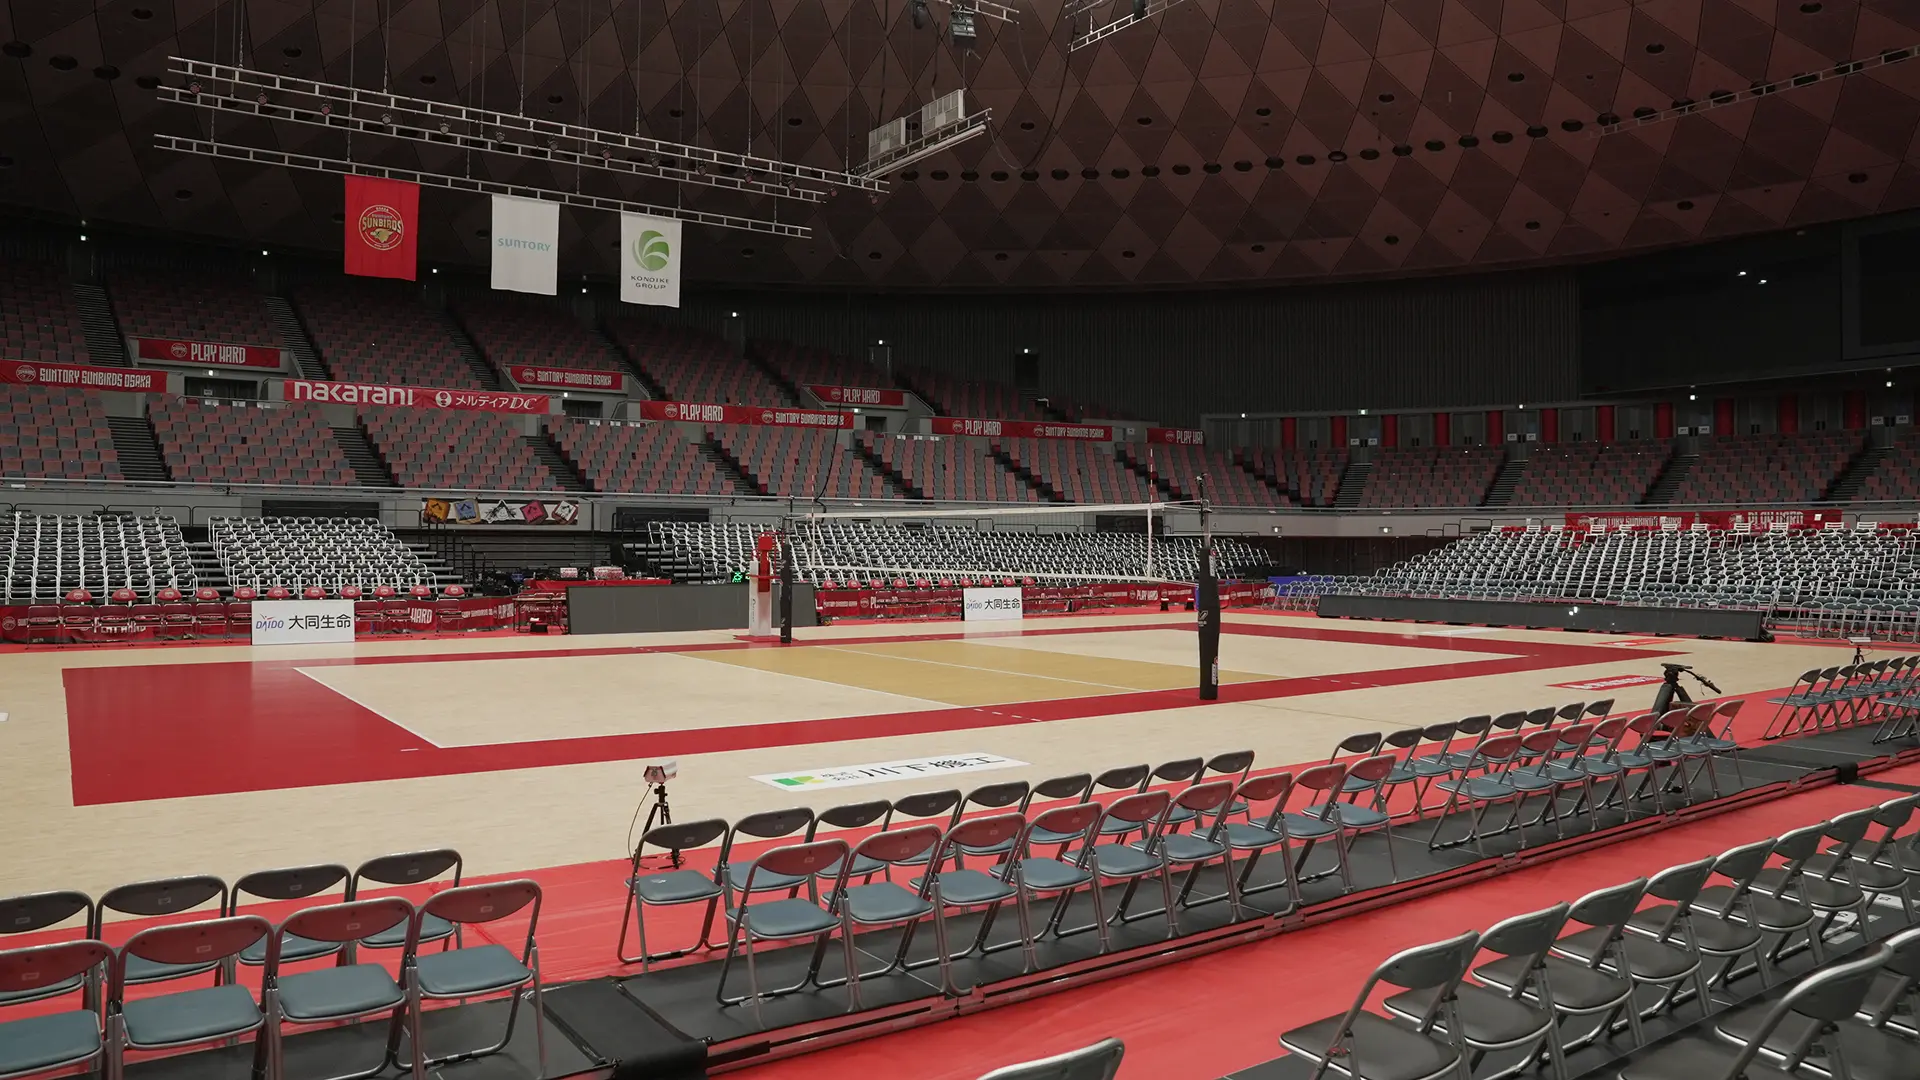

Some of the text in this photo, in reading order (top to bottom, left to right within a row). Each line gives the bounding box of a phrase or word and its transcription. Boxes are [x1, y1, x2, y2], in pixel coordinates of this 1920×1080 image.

[362, 216, 402, 234] SUNBIRDS
[497, 237, 551, 252] SUNTORY
[630, 275, 669, 284] KONOIKE
[635, 282, 667, 290] GROUP
[190, 343, 246, 364] PLAY HARD
[39, 367, 151, 389] SUNTORY SUNBIRDS OSAKA
[843, 388, 880, 404] PLAY HARD
[680, 403, 723, 422] PLAY HARD
[965, 420, 1001, 436] PLAY HARD
[1176, 430, 1192, 444] PLAY
[984, 598, 1021, 610] 大同生命
[289, 613, 351, 630] 大同生命
[411, 607, 433, 624] HARD
[256, 619, 284, 632] DAIDO
